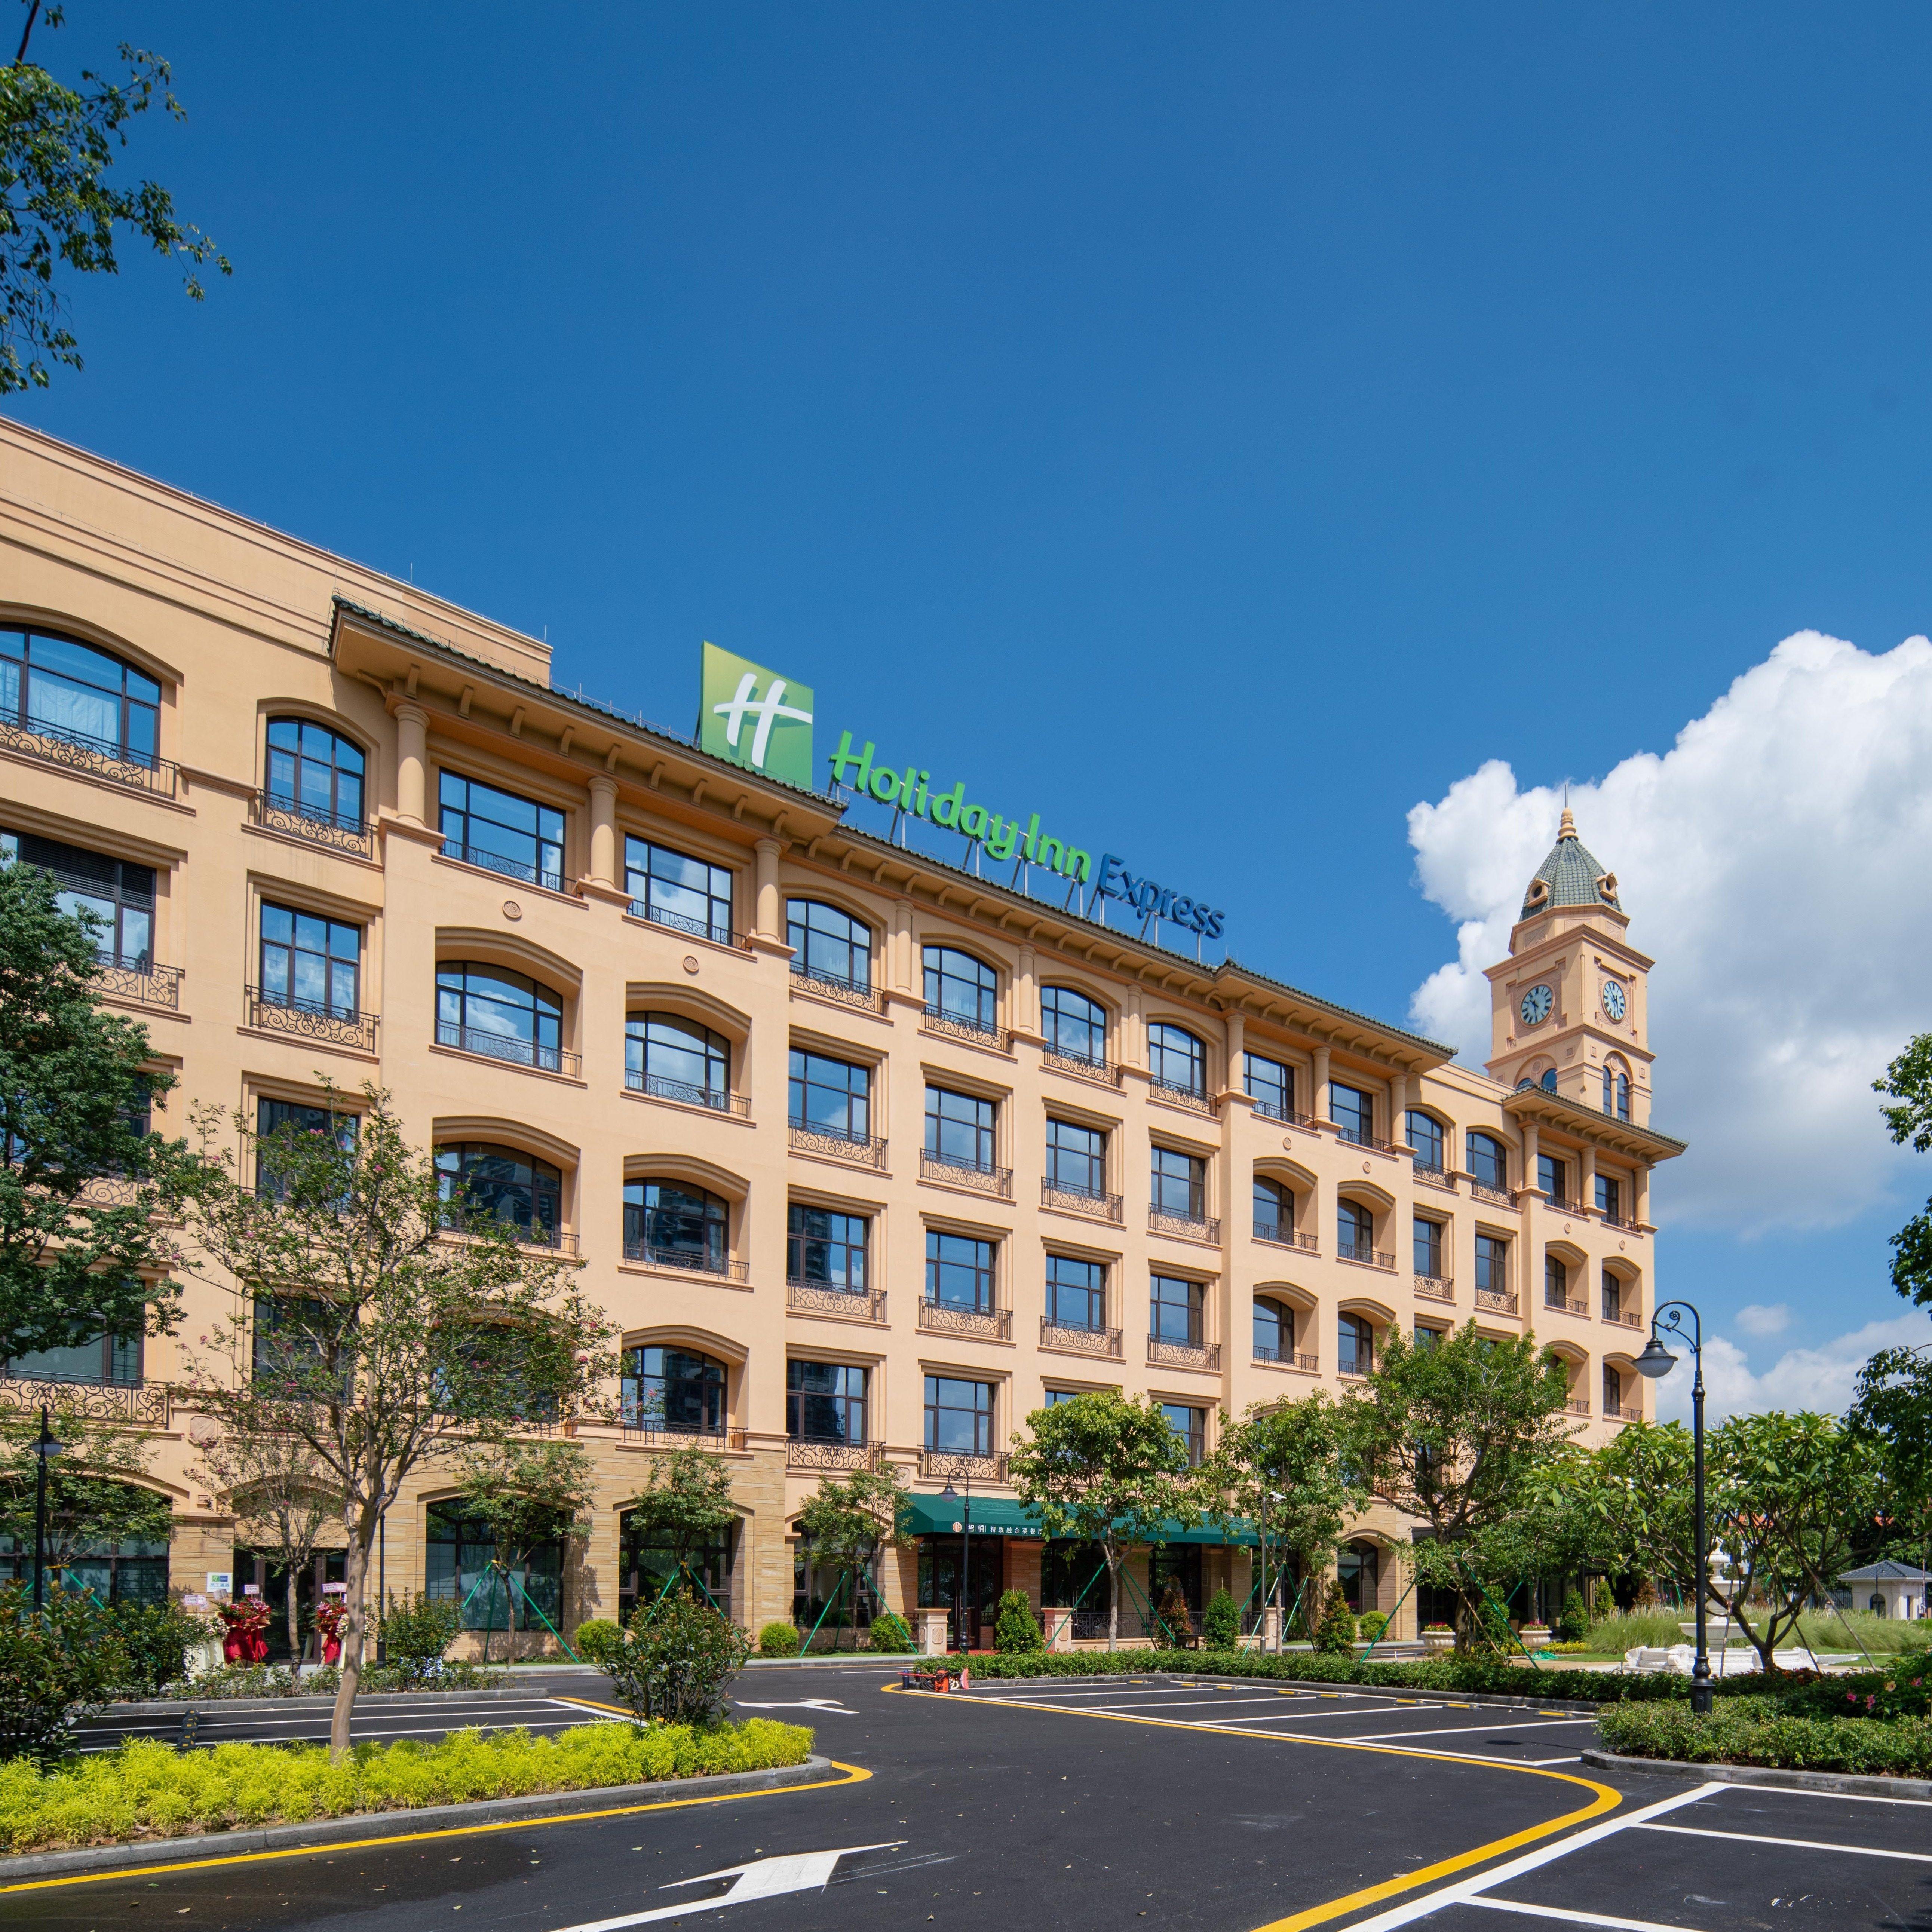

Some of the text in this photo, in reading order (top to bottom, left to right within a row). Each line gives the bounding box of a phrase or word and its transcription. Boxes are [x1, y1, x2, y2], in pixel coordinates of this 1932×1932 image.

[828, 730, 1226, 940] Holiday Inn Express
